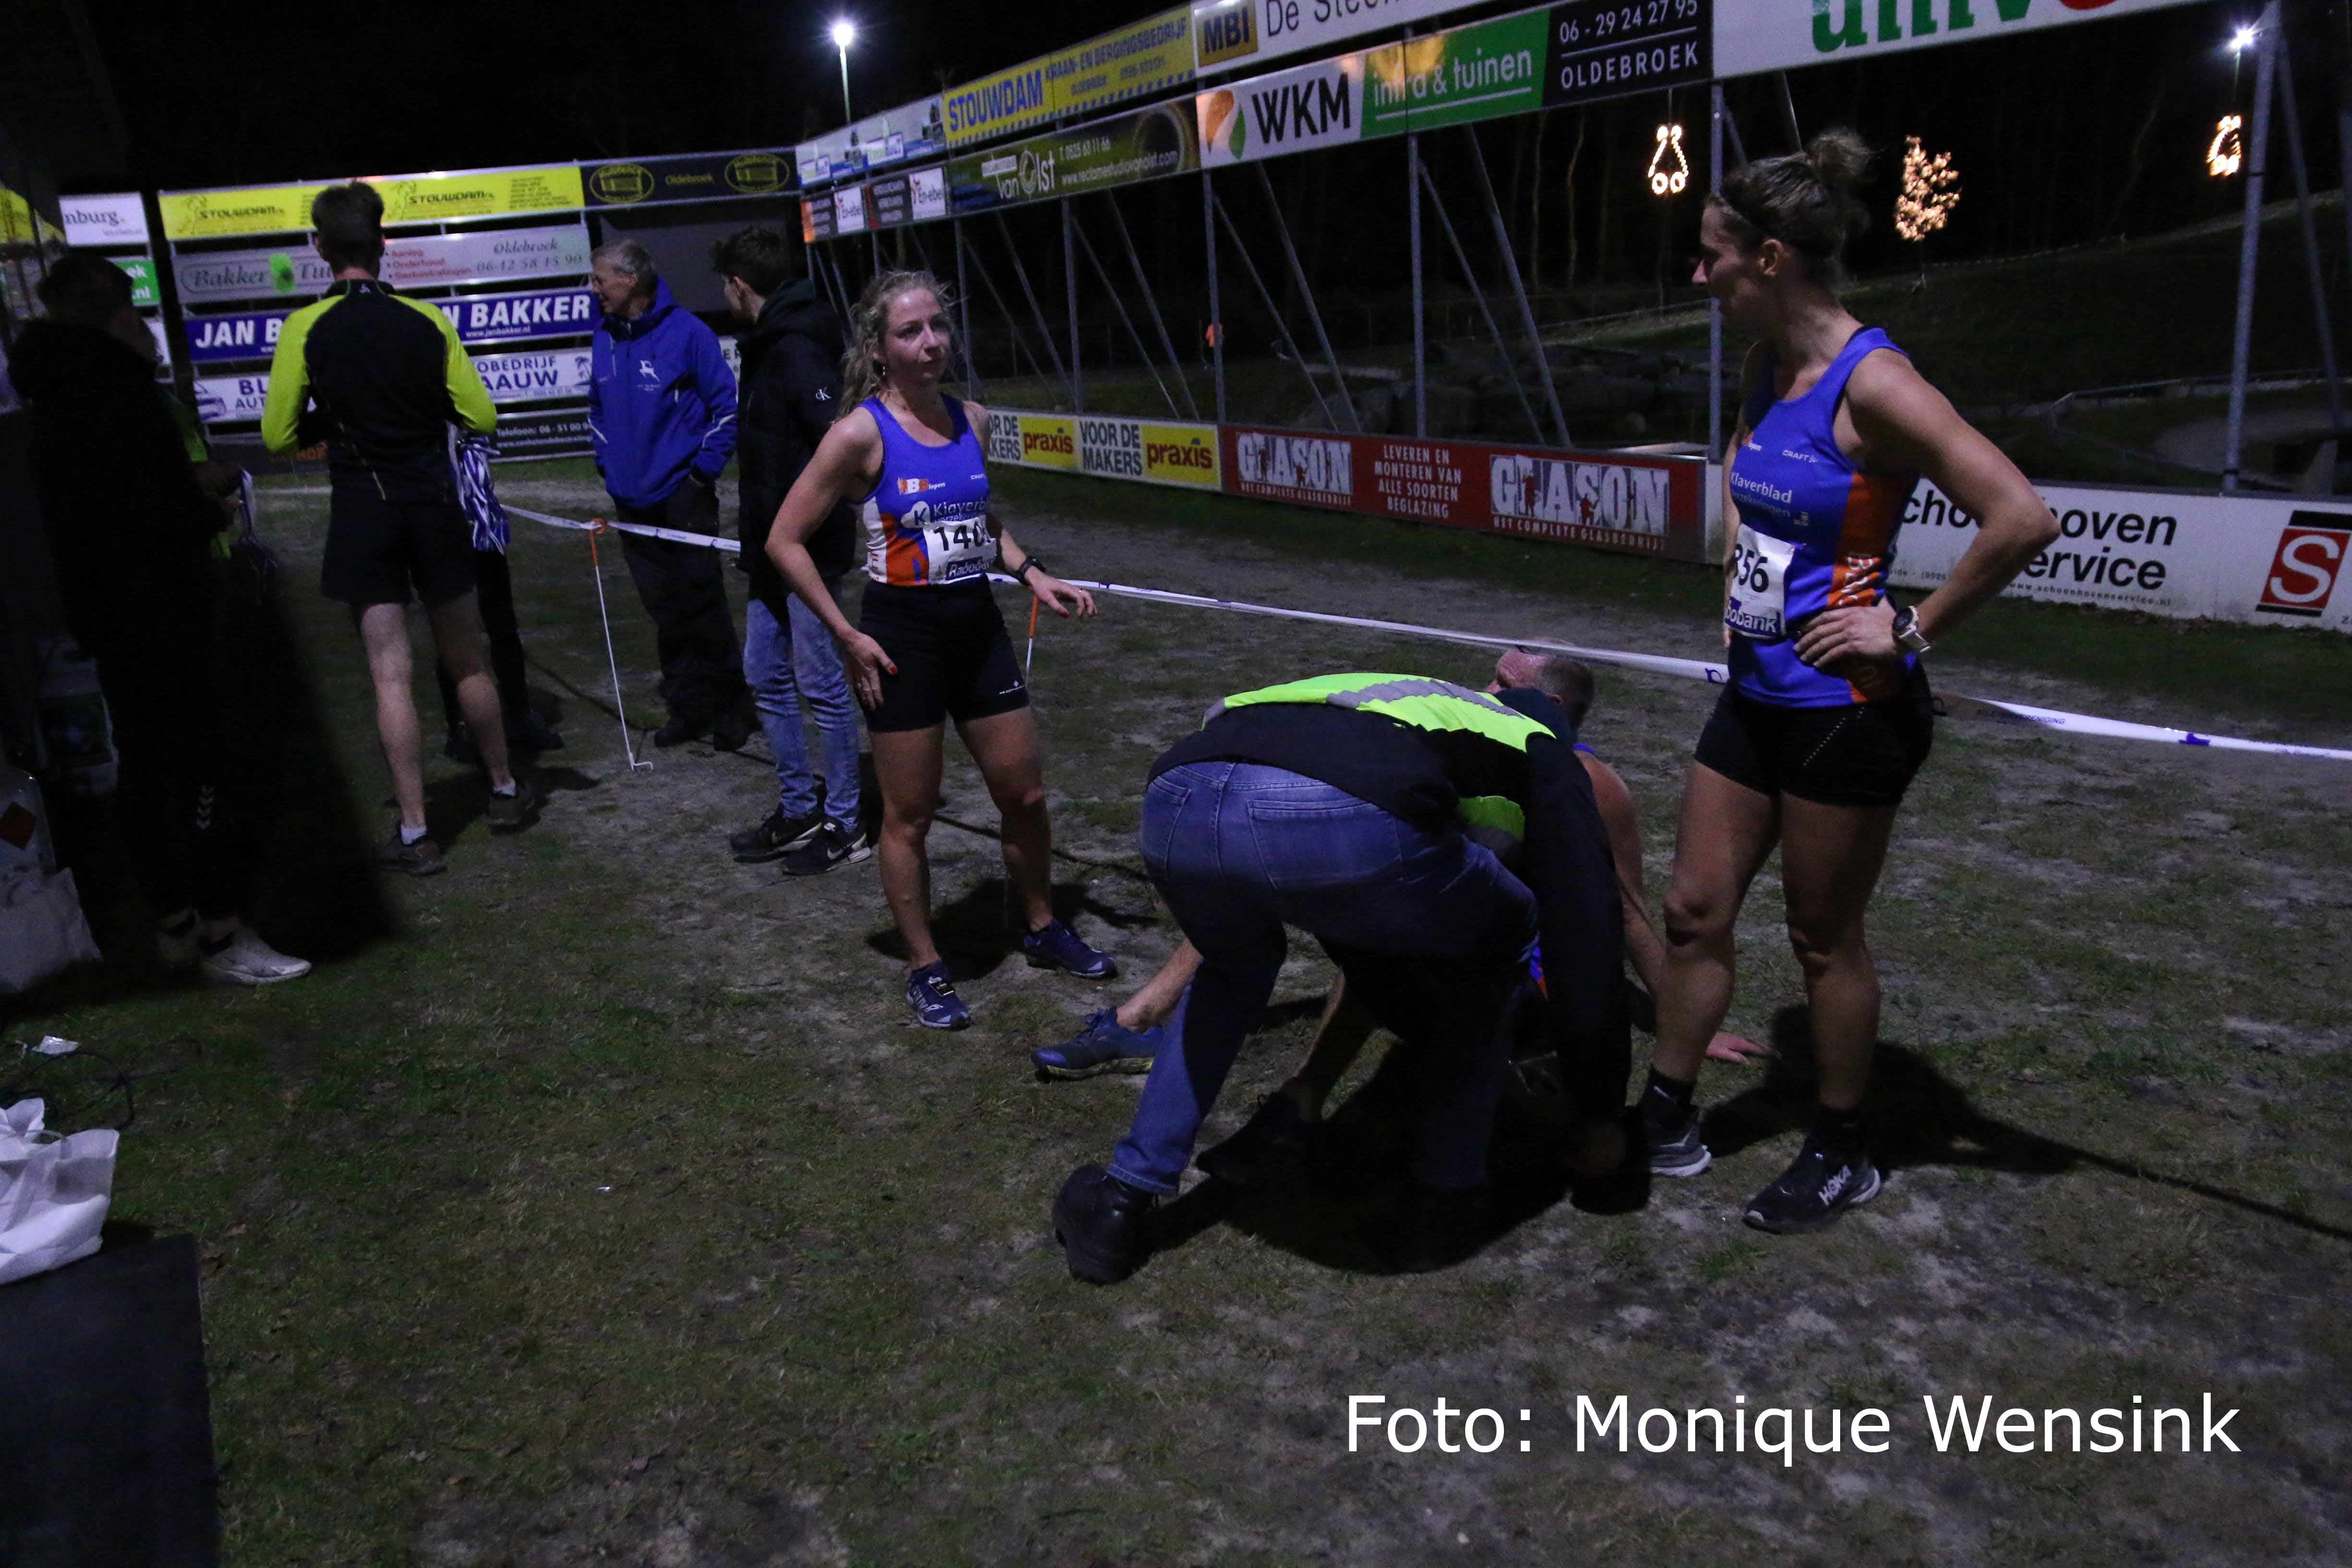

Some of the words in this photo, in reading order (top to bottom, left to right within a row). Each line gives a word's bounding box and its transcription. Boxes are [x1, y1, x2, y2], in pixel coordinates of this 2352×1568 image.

[1203, 7, 1249, 54] MBI
[1267, 0, 1299, 37] De
[1560, 20, 1579, 44] 06
[1595, 11, 1616, 37] 29
[1621, 5, 1642, 31] 24
[1648, 0, 1669, 24] 27
[1433, 66, 1448, 96] &
[1453, 49, 1532, 91] tuinen
[1561, 40, 1698, 89] OLDEBROEK
[947, 69, 1043, 133] STOUWDAM
[1251, 73, 1351, 145] WKM
[493, 239, 558, 255] Oldebroek
[193, 264, 266, 287] Bakker
[470, 294, 591, 329] BAKKER
[194, 318, 255, 349] JAN
[1003, 415, 1019, 438] DE
[1079, 420, 1119, 447] VOOR
[1121, 425, 1140, 449] DE
[1023, 431, 1074, 455] praxis
[1146, 442, 1213, 469] praxis
[1383, 444, 1431, 463] LEVEREN
[1435, 449, 1450, 464] EN
[1782, 450, 1810, 461] CRAFT
[1081, 449, 1142, 476] MAKERS
[1374, 460, 1432, 481] MONTEREN
[1437, 467, 1462, 485] VAN
[1378, 478, 1404, 495] ALLE
[1406, 482, 1459, 502] SOORTEN
[1386, 496, 1450, 519] BEGLAZING
[2023, 546, 2167, 590] ervice
[2270, 534, 2340, 603] S
